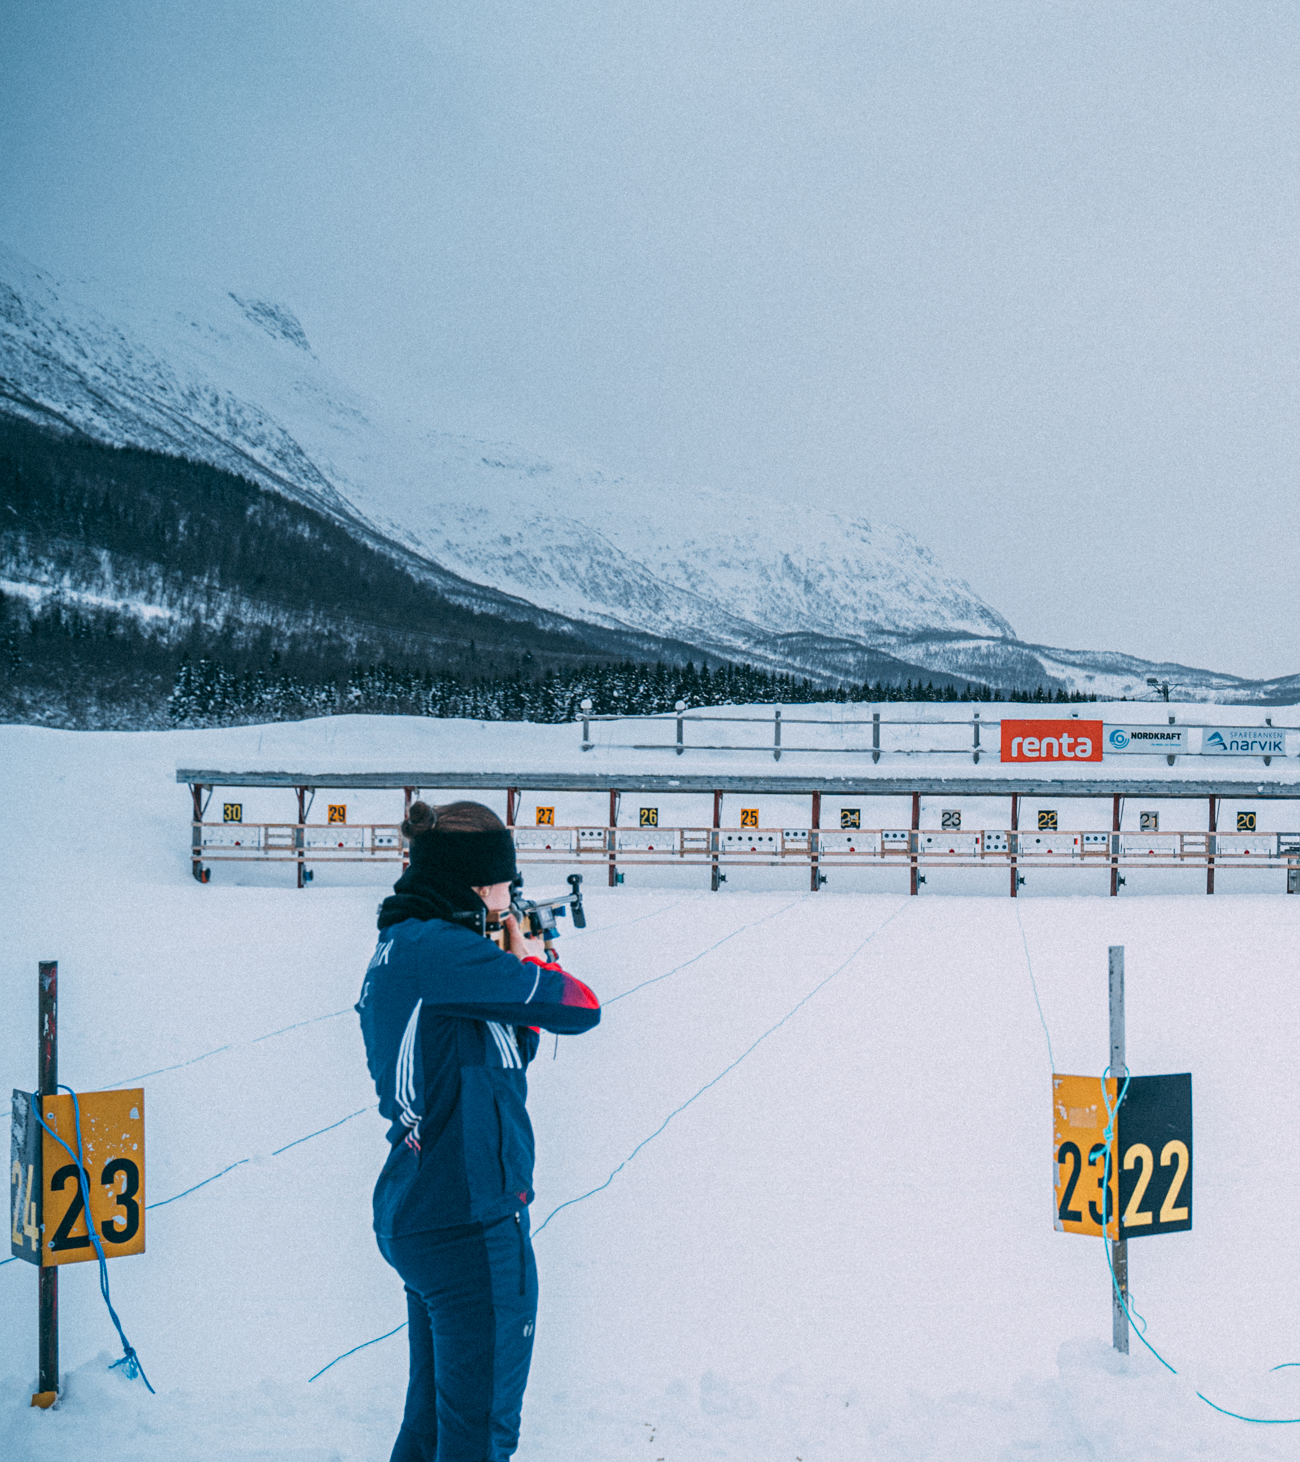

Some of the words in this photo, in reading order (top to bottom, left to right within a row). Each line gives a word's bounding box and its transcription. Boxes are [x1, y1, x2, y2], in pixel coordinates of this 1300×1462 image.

[1130, 732, 1182, 740] NORDKRAFT
[1011, 732, 1092, 758] renta
[1230, 740, 1282, 751] narvik
[224, 805, 241, 821] 30
[330, 806, 346, 822] 29
[538, 808, 554, 824] 27
[640, 809, 658, 825] 26
[742, 810, 758, 826] 25
[841, 811, 860, 827] 24
[942, 811, 961, 826] 23
[1038, 812, 1057, 828] 22
[1140, 813, 1158, 828] 21
[1238, 814, 1256, 829] 20
[1058, 1141, 1113, 1225] 23
[1123, 1140, 1189, 1227] 22
[12, 1160, 39, 1252] 24
[50, 1158, 139, 1252] 23
